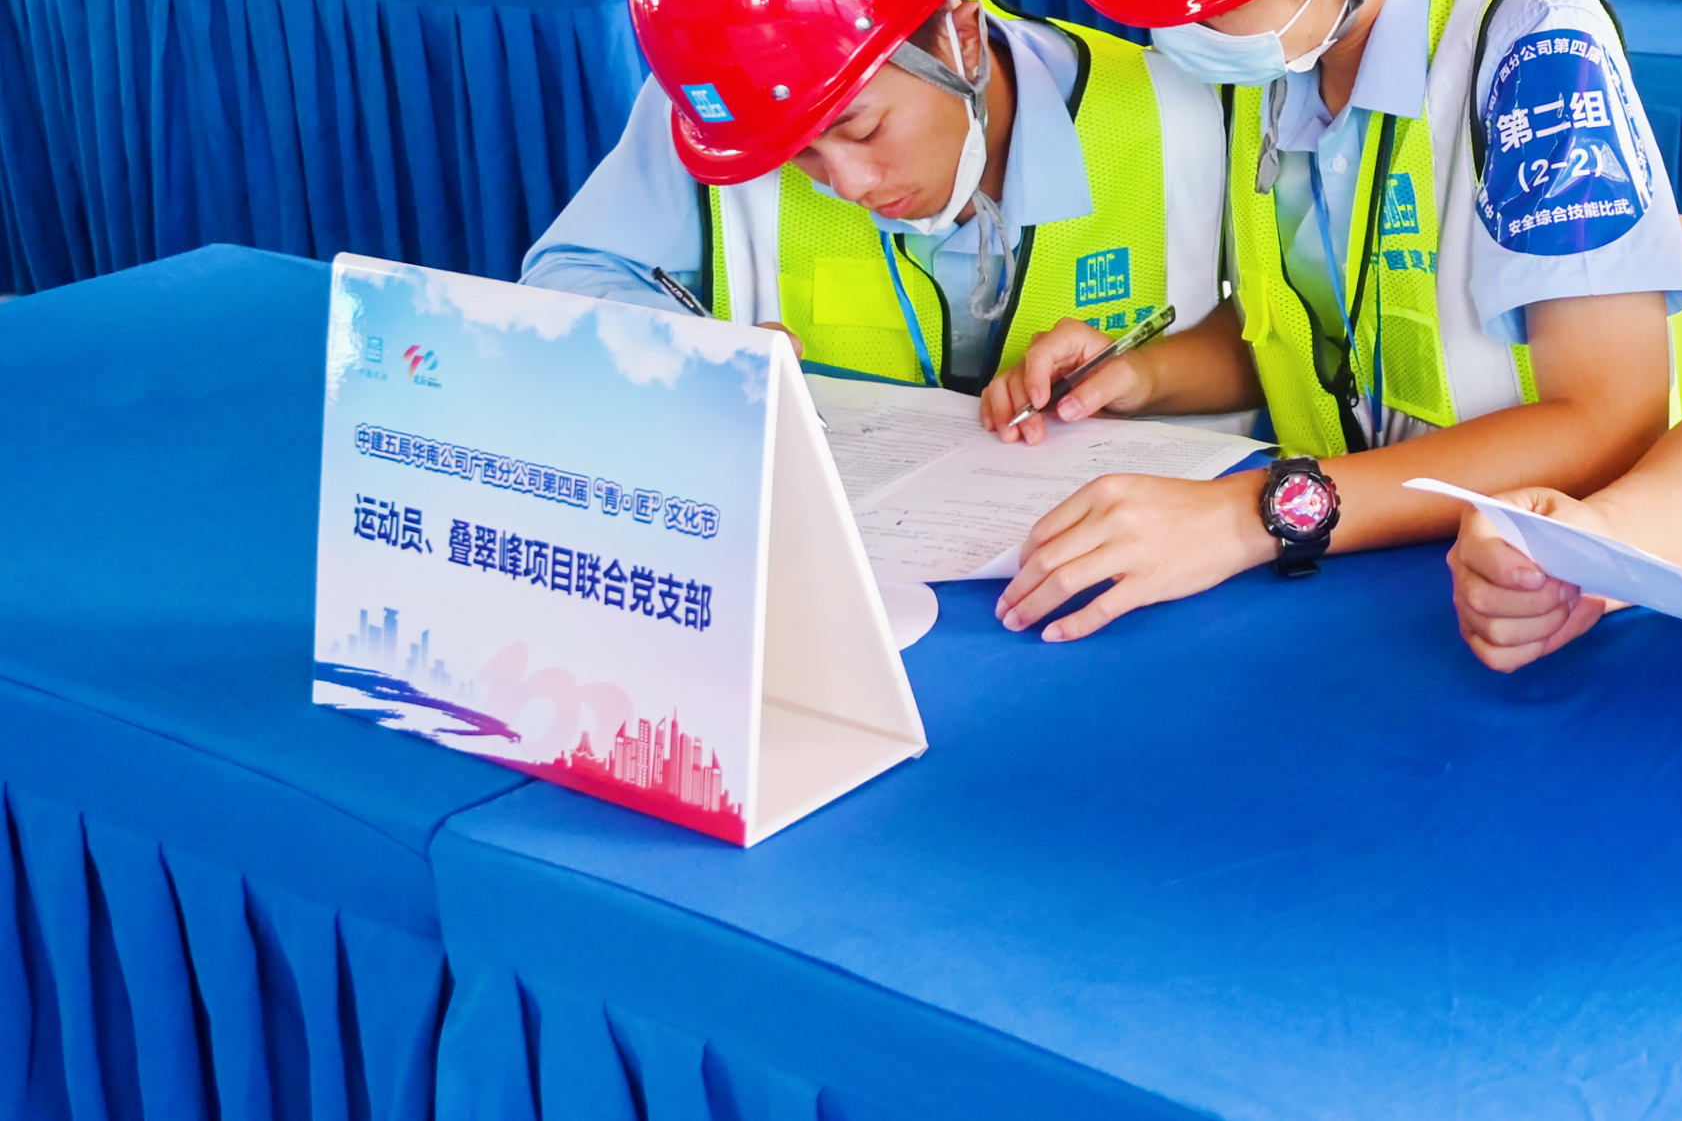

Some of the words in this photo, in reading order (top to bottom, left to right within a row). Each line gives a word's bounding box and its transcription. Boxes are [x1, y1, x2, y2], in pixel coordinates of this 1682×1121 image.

[1496, 90, 1611, 154] 第二组
[1518, 144, 1602, 194] (2-2)
[1508, 198, 1631, 237] 安全综合技能比武
[353, 492, 714, 632] 运动员、叠翠峰项目联合党支部
